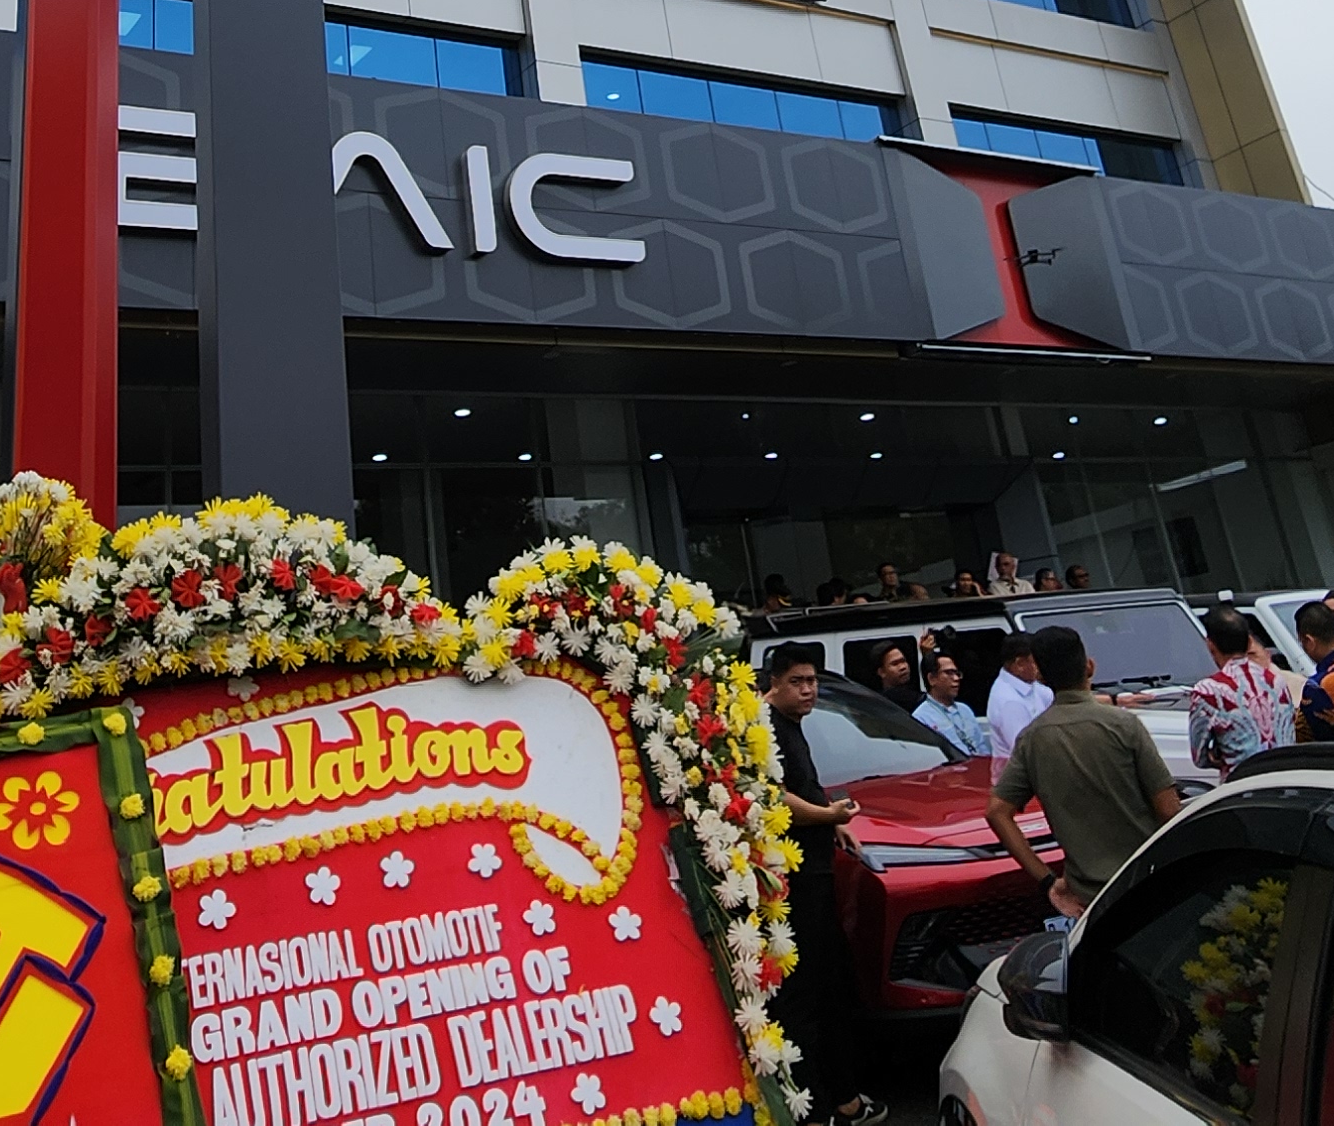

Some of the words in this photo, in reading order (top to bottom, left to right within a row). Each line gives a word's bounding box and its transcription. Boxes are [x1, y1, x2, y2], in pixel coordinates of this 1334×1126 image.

[181, 929, 364, 1009] ERNASIONAL
[368, 904, 502, 973] OTOMOTIF
[191, 988, 343, 1064] GRAND
[352, 957, 516, 1028] OPENING
[522, 946, 571, 996] OF
[212, 1023, 440, 1126] AUTHORIZED
[447, 985, 636, 1088] DEALERSHIP
